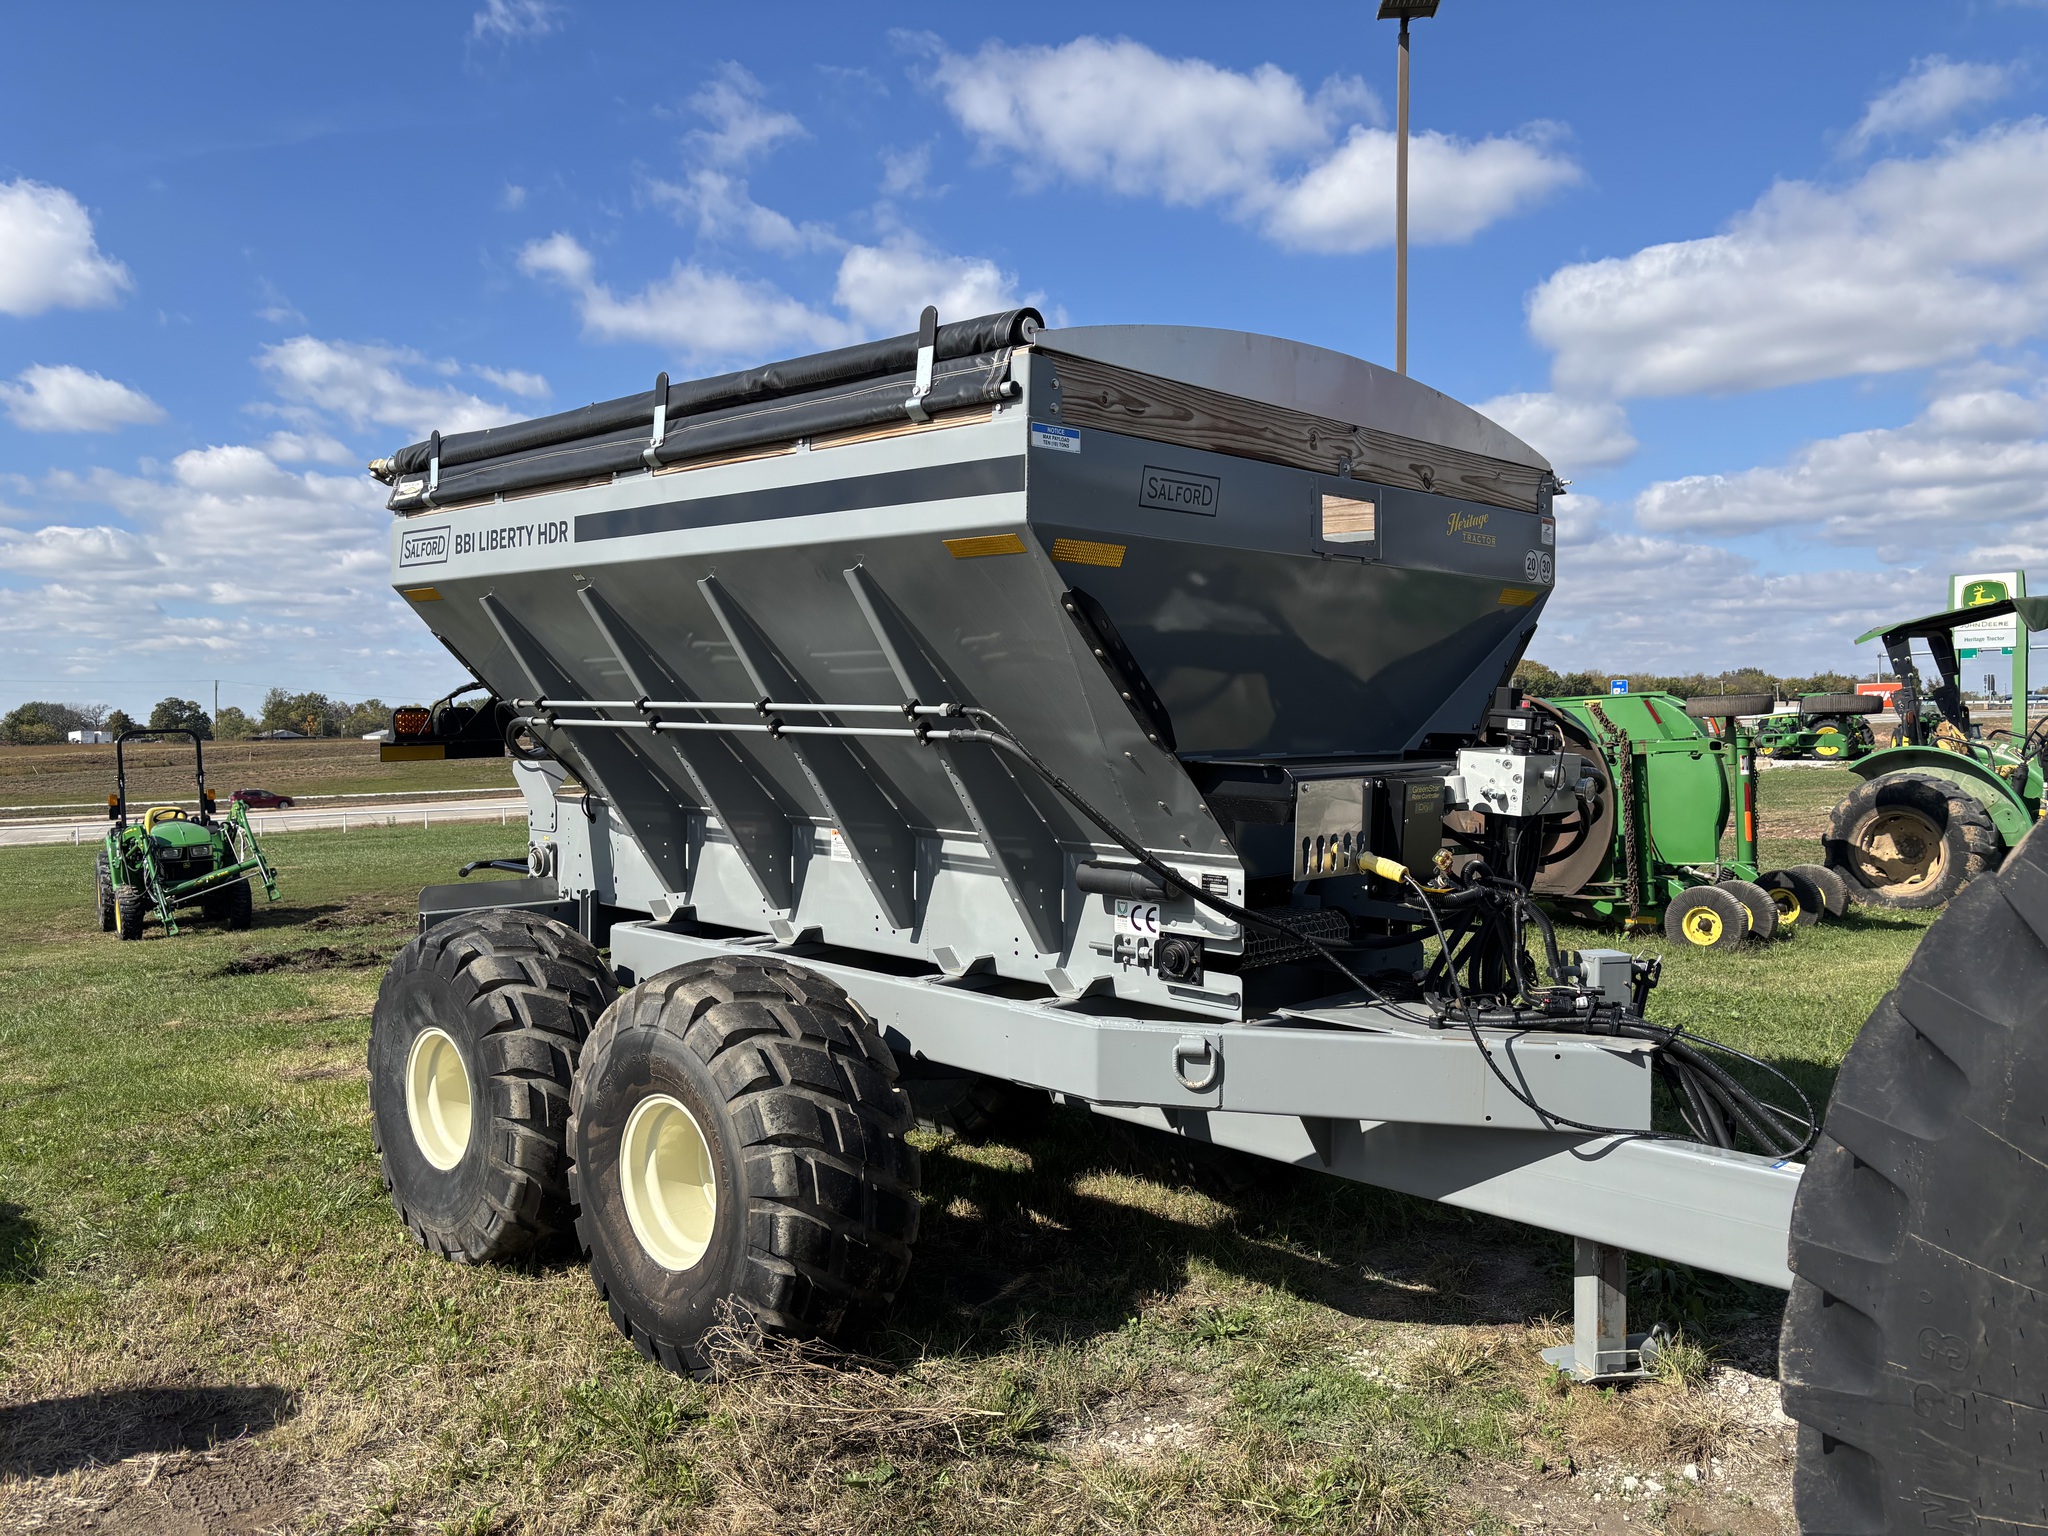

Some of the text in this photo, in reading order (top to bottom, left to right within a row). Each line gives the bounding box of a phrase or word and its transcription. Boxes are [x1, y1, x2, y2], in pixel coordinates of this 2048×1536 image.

[1047, 427, 1065, 435] NOTICE
[1052, 435, 1069, 443] PAYLOAD
[1147, 477, 1213, 506] SALFORD
[1446, 511, 1489, 536] Heritage
[404, 520, 568, 559] SALFORD BBI LIBERTY HDR
[1463, 533, 1496, 545] TRACTOR
[1527, 557, 1536, 571] 20
[1542, 560, 1551, 574] 30
[1412, 784, 1440, 793] GreenStar
[1418, 803, 1429, 813] Dry
[1131, 904, 1157, 933] CE
